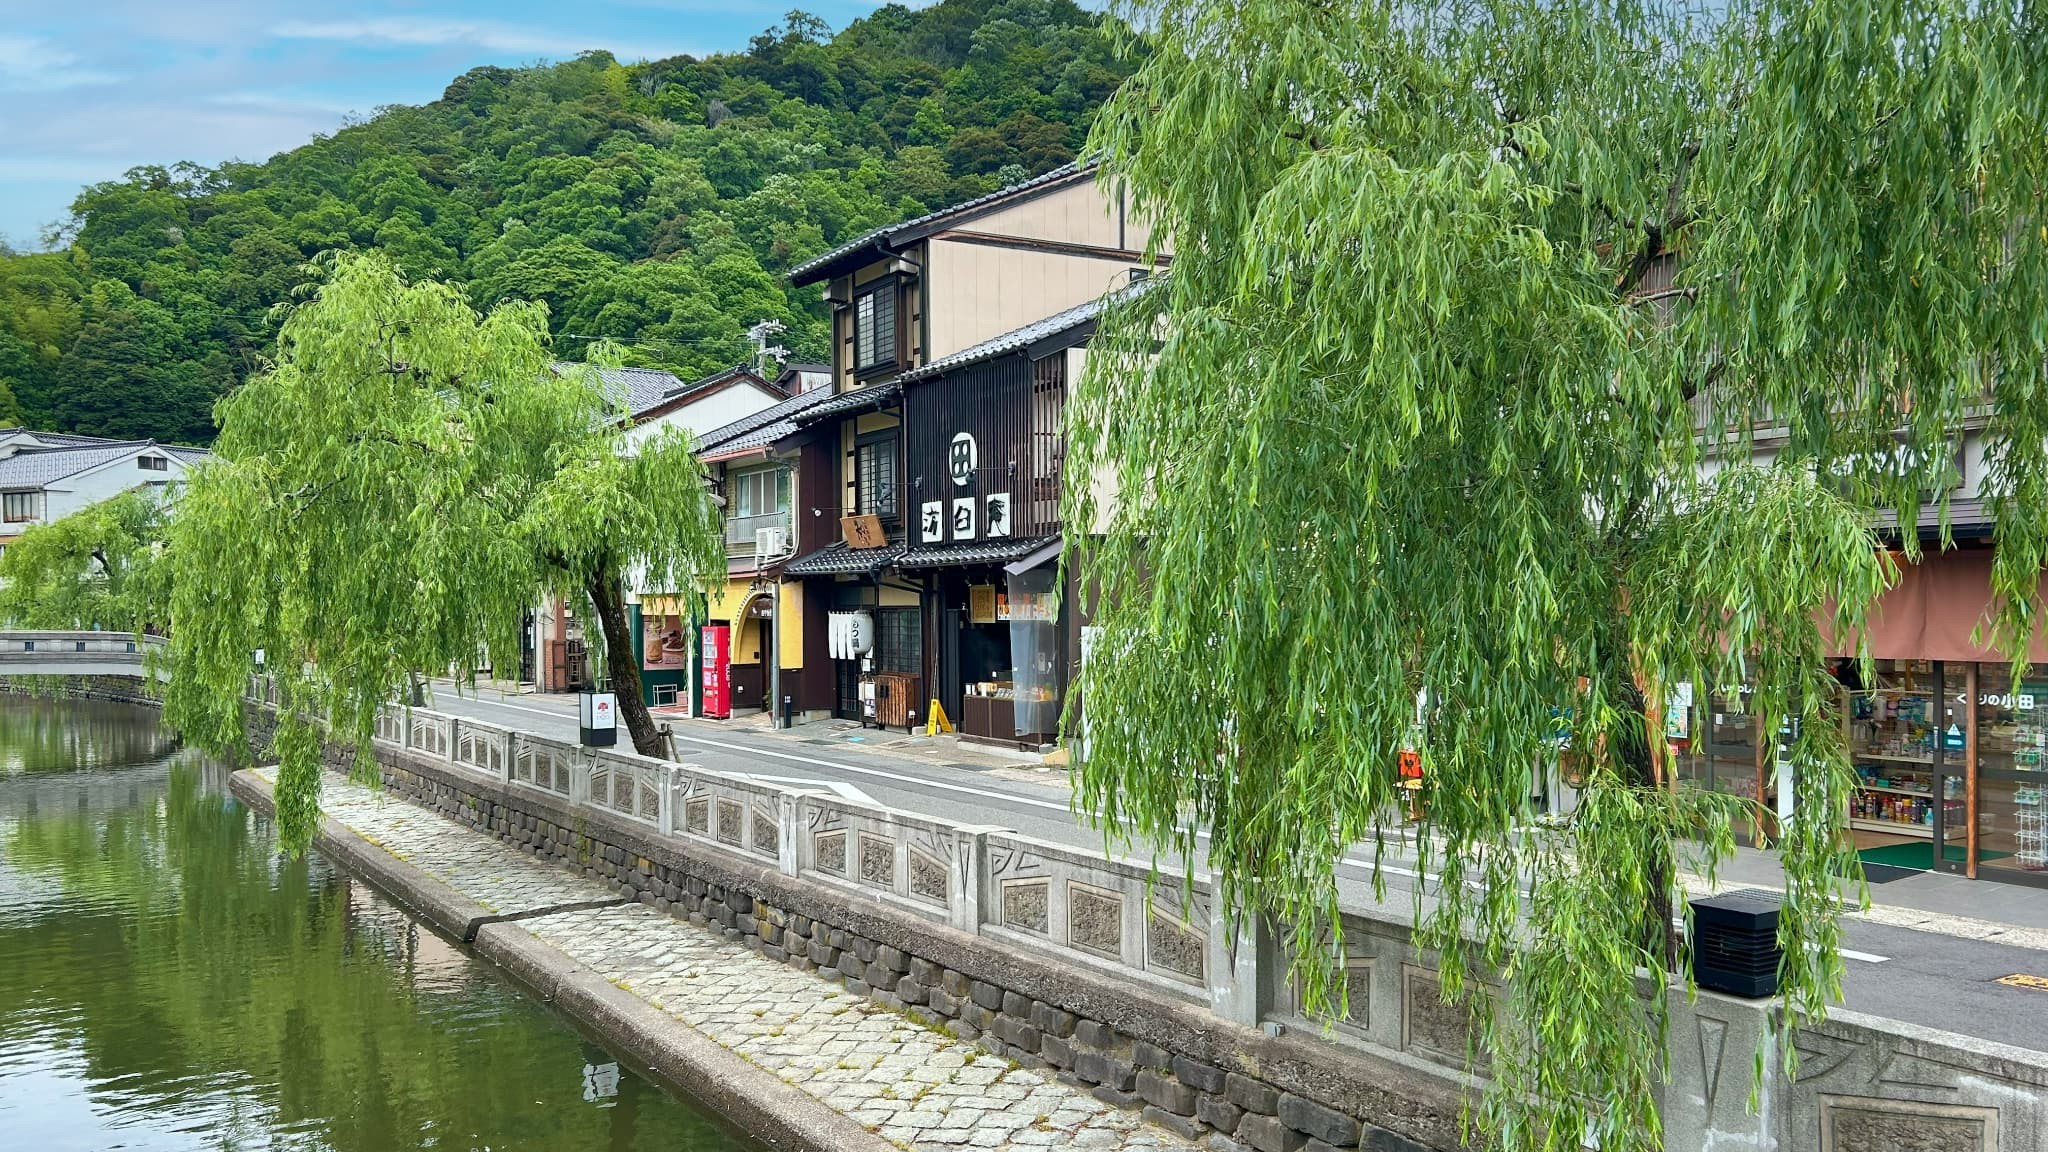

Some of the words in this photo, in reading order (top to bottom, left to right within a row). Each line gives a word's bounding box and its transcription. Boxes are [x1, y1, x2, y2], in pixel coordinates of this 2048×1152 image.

[1956, 692, 2035, 711] くりの小田
